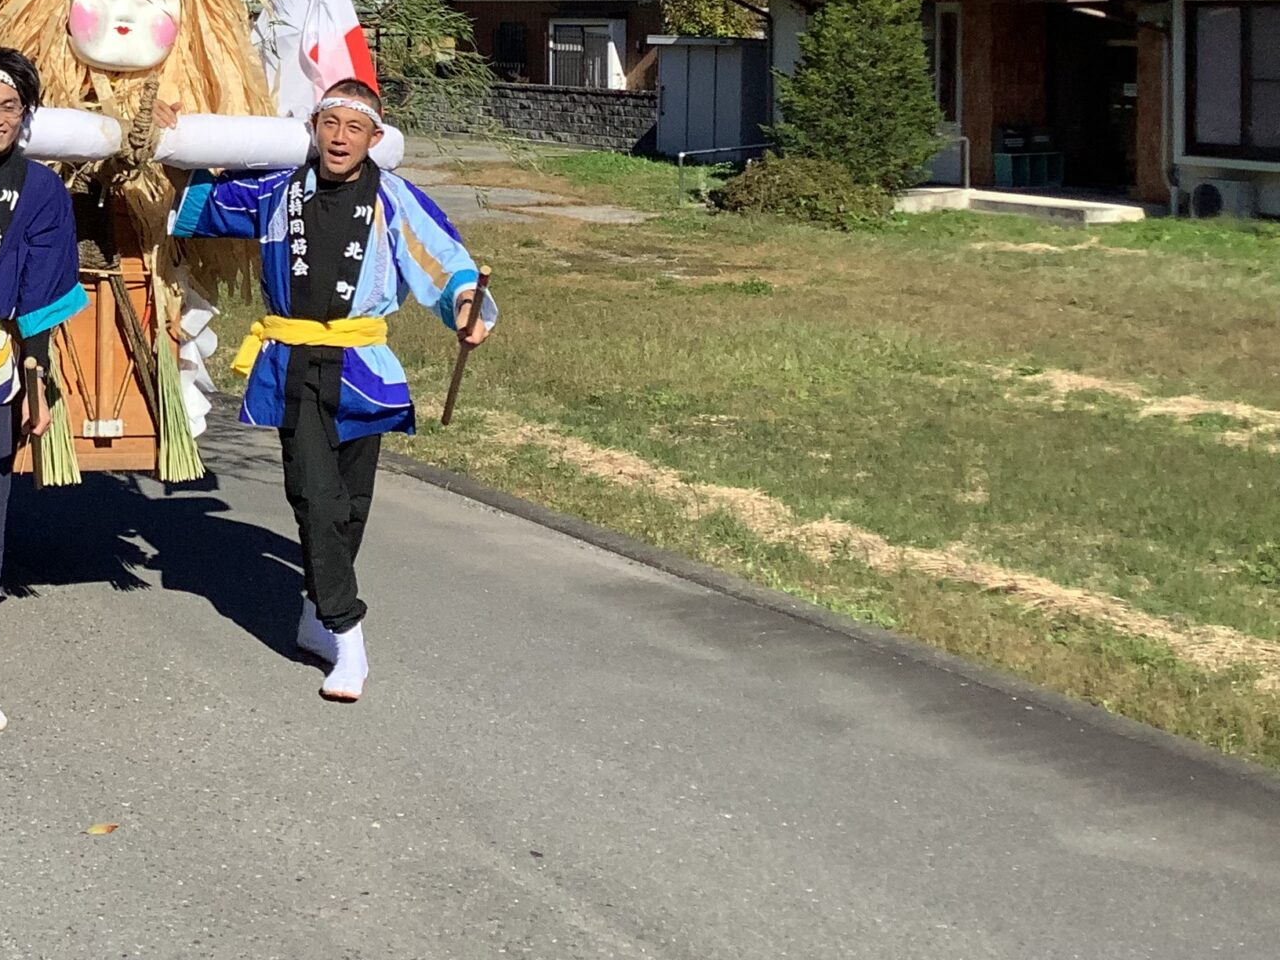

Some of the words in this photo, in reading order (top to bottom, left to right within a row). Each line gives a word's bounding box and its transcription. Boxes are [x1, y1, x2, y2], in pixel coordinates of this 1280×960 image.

[288, 181, 310, 276] 長持同好会
[336, 205, 373, 300] 川北町
